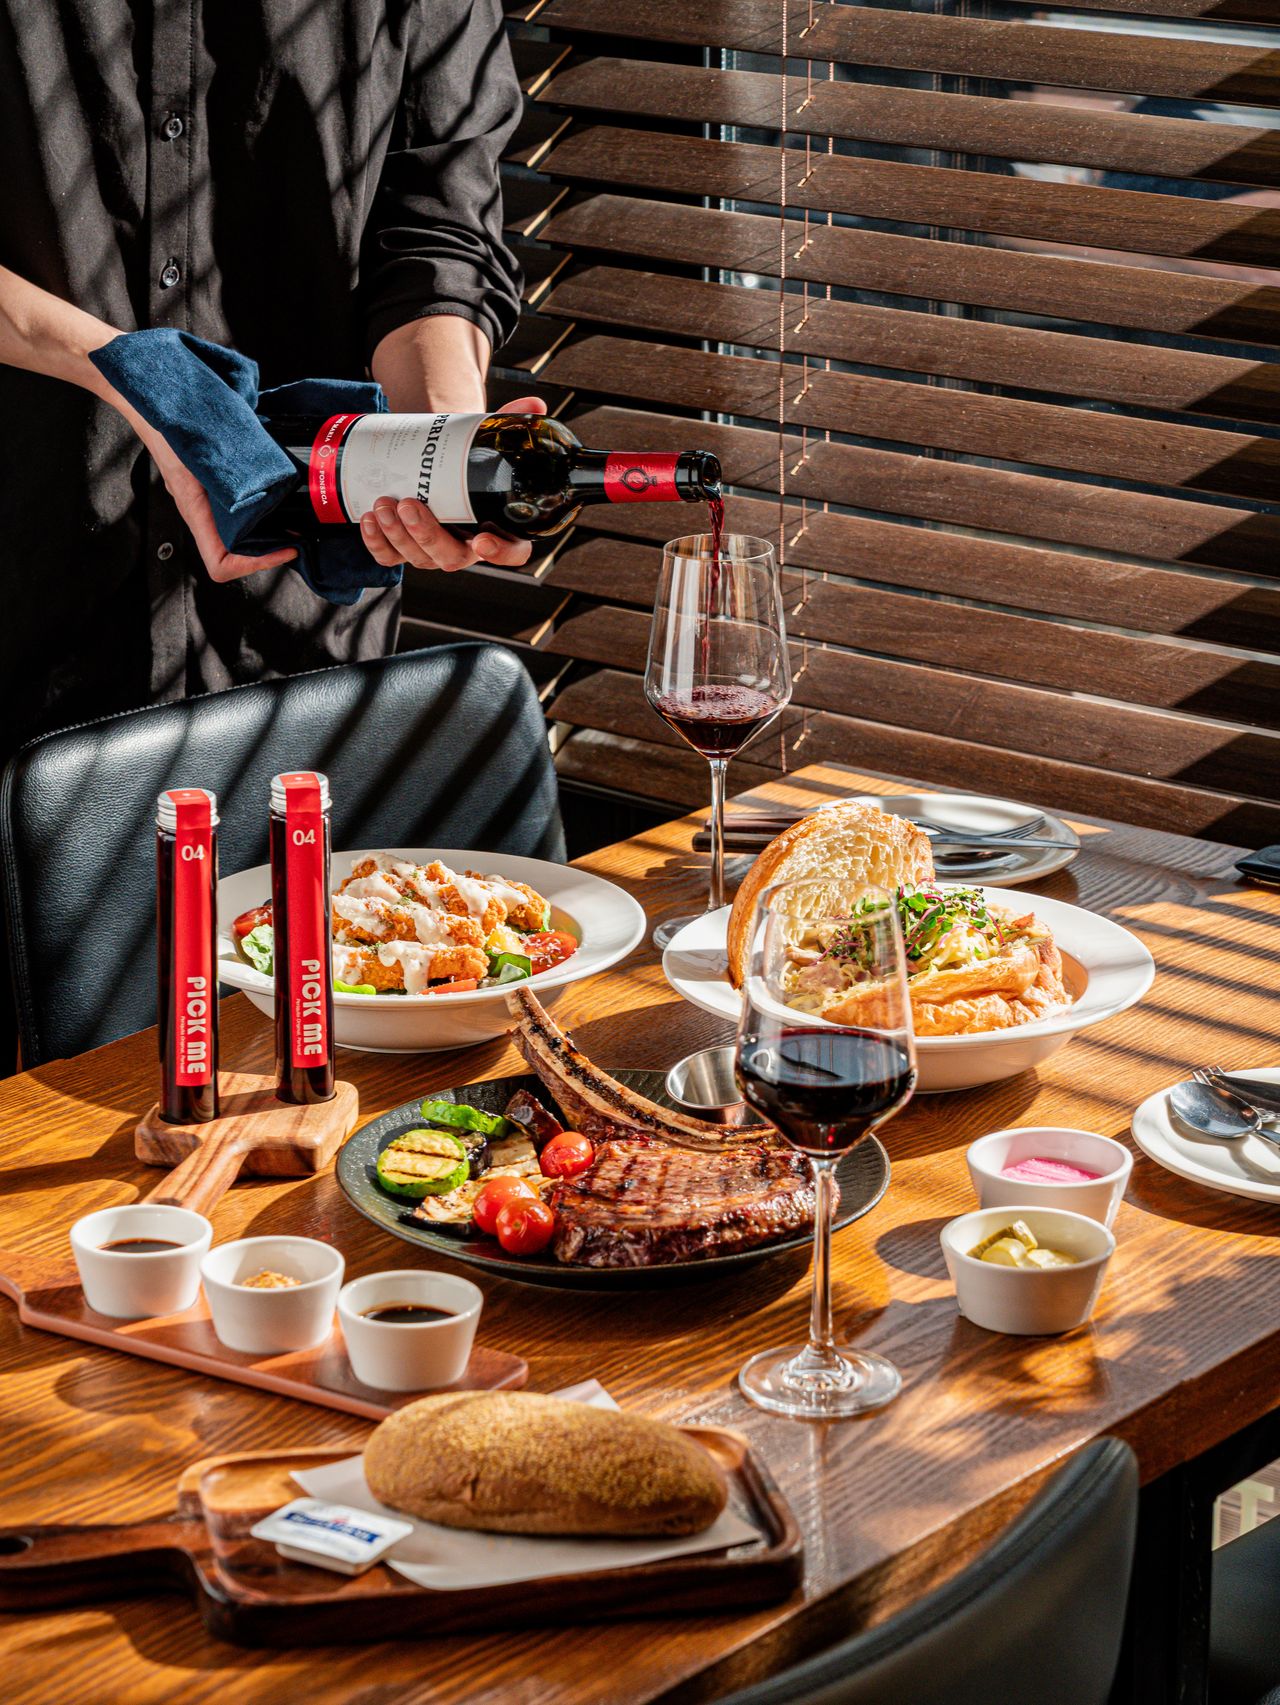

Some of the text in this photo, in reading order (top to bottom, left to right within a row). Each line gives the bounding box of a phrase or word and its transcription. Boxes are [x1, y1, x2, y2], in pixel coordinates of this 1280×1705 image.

[324, 423, 339, 442] MARIA
[417, 414, 449, 505] PERIQUITA
[319, 470, 328, 505] FONSECA
[181, 844, 205, 861] 04
[292, 829, 316, 846] 04
[301, 959, 323, 1055] PICK ME
[186, 976, 207, 1074] PICK ME
